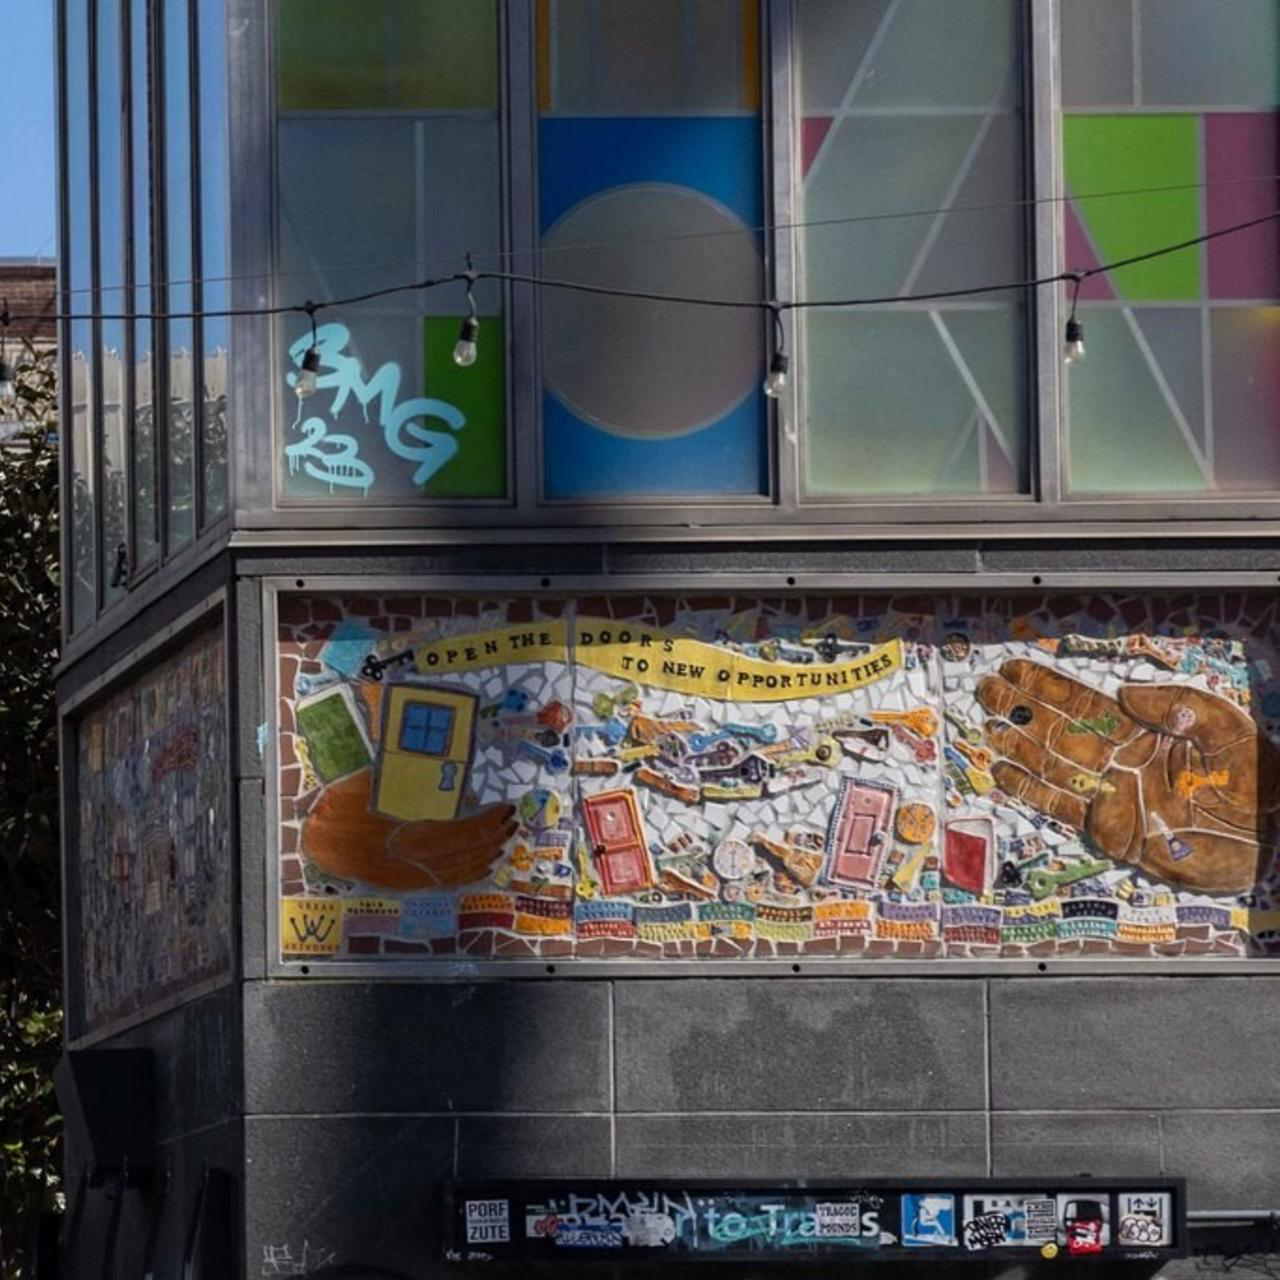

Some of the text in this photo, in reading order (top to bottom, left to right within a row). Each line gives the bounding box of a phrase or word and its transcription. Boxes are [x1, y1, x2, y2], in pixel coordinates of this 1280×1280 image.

[427, 631, 674, 667] OPEN THE DOORS
[621, 653, 893, 689] TO NEW OPPORTUNITIES
[760, 1203, 880, 1237] Tras
